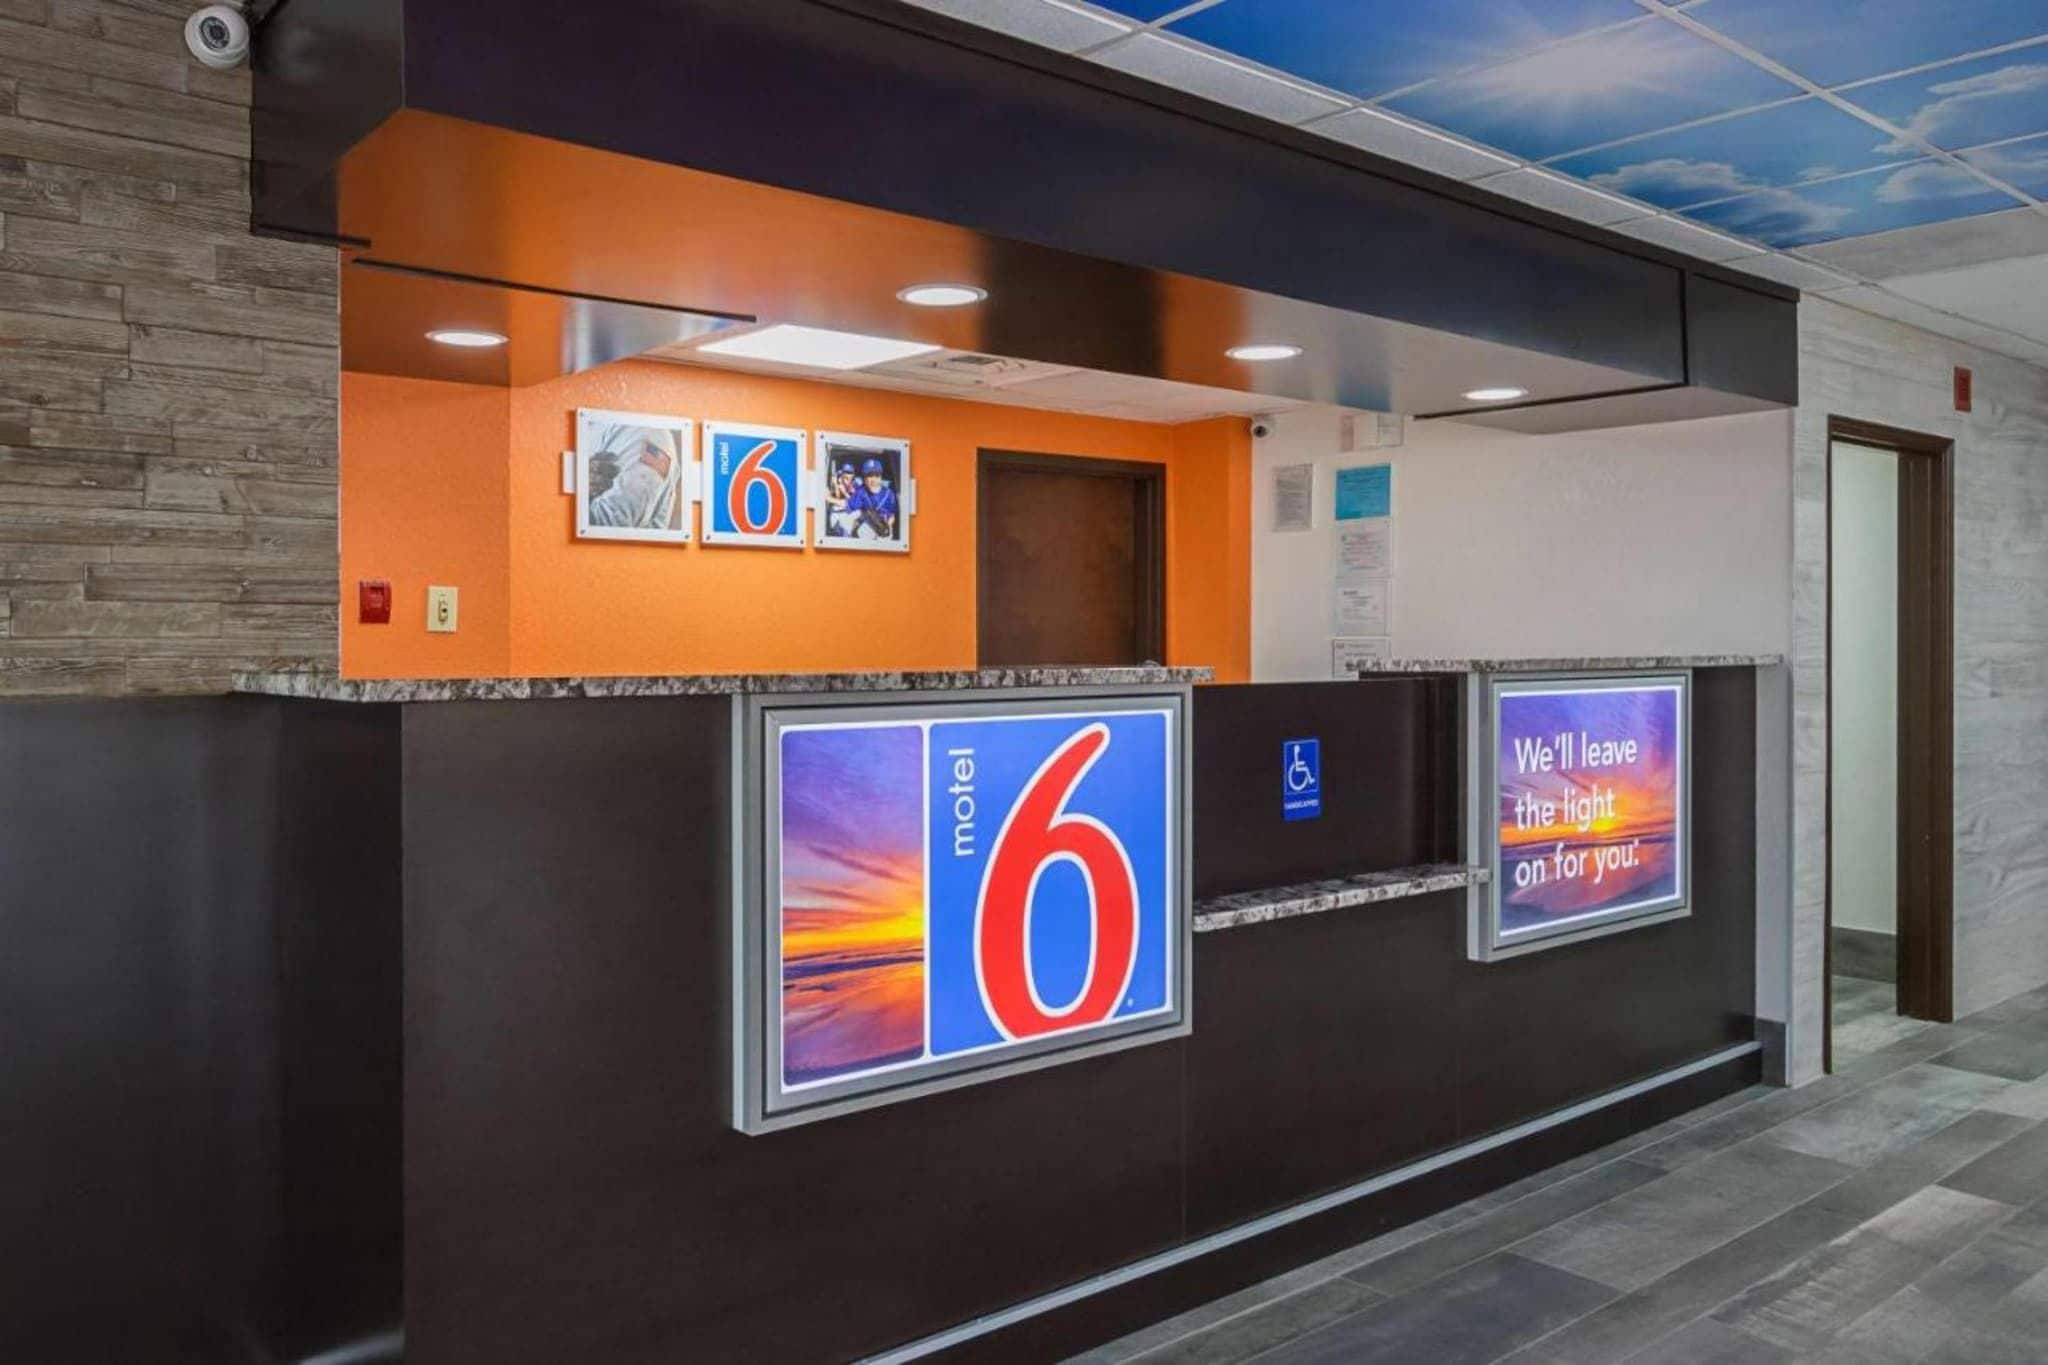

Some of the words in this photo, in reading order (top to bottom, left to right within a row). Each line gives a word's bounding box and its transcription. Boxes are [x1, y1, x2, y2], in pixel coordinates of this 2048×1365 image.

[720, 442, 729, 475] motel
[729, 440, 787, 535] 6
[1514, 732, 1574, 774] We'll
[1581, 731, 1638, 768] leave
[1515, 792, 1555, 830] the
[1563, 784, 1616, 832] light
[948, 748, 975, 856] motel
[974, 722, 1140, 1042] 6
[1515, 859, 1546, 887] on
[1554, 842, 1588, 880] for
